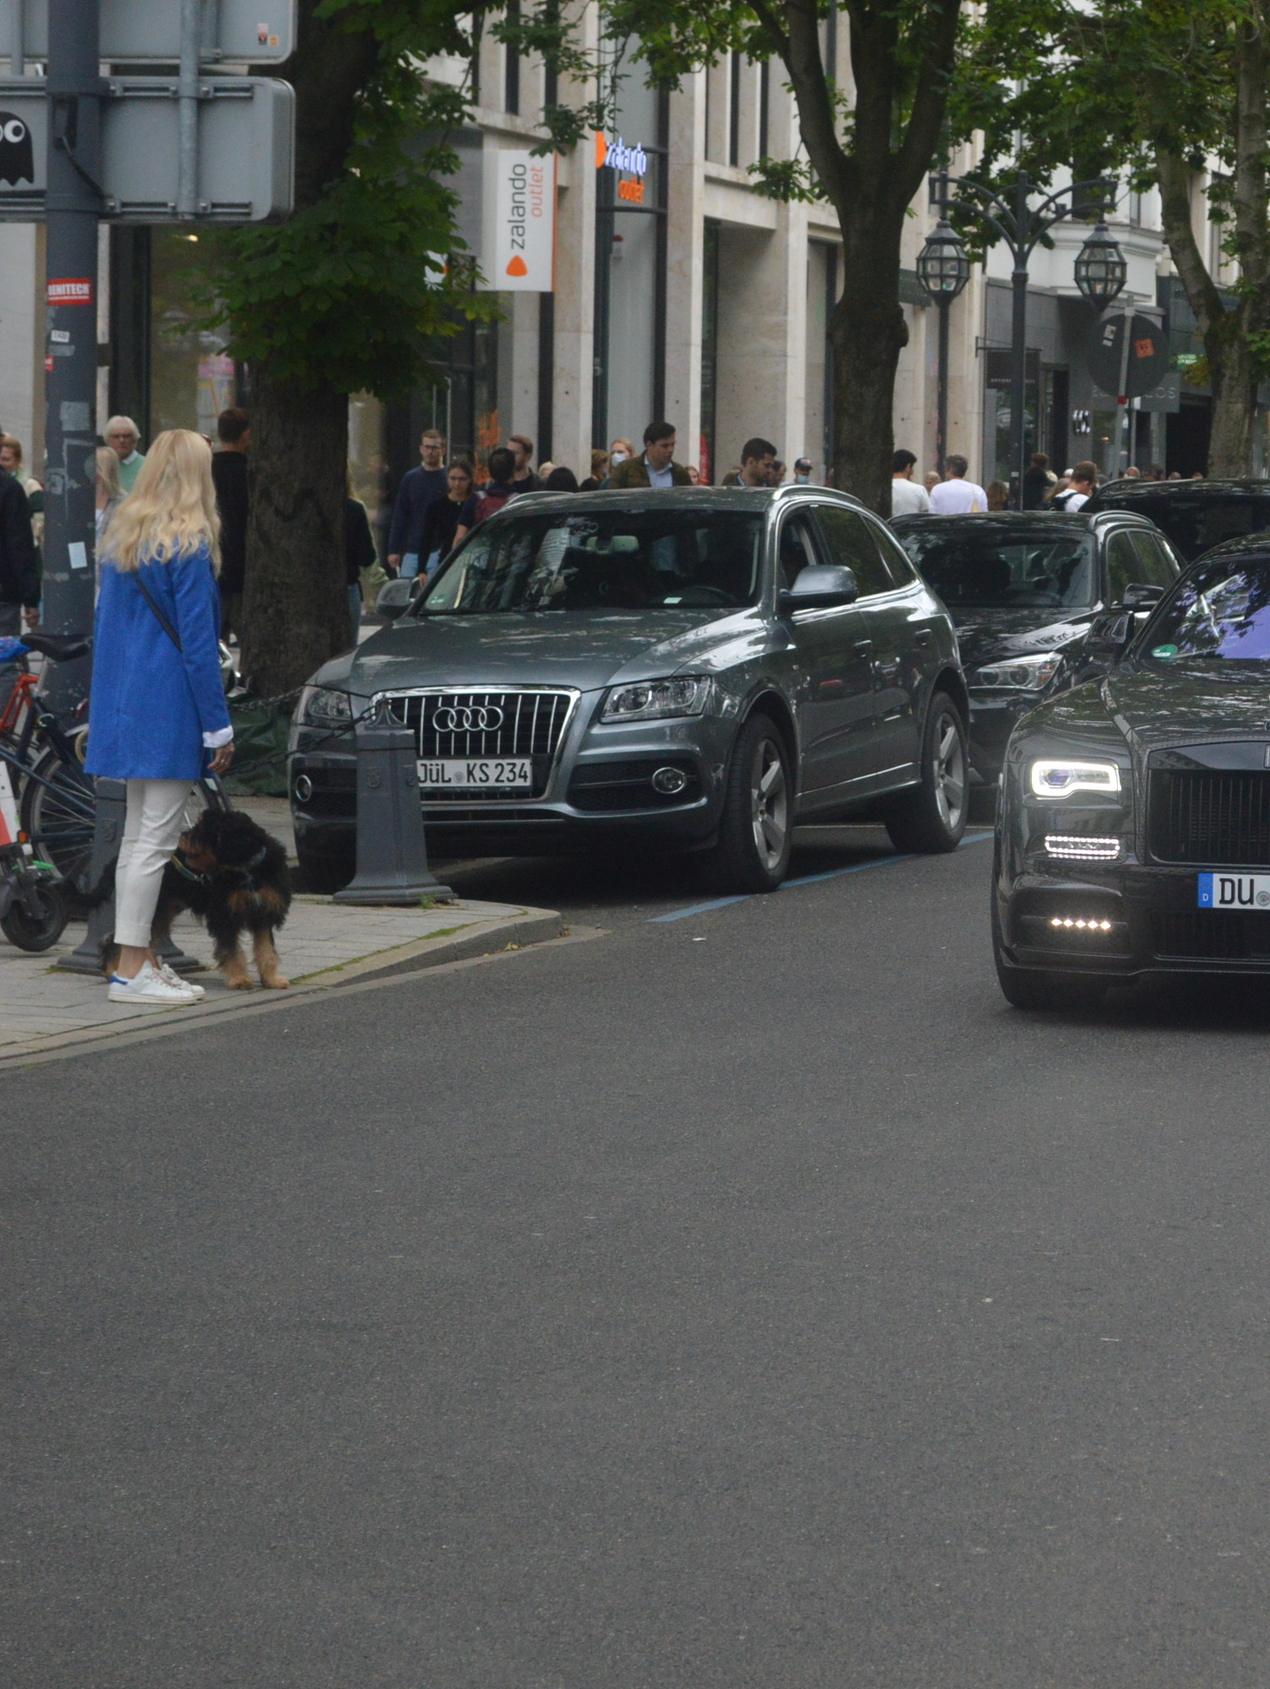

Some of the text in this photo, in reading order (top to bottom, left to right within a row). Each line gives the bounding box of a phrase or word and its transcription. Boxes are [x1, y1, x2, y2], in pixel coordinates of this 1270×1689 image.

[605, 137, 646, 176] zalando
[508, 163, 527, 250] zalando
[529, 166, 544, 218] outlet
[466, 763, 489, 783] KS
[494, 762, 528, 783] 234
[1218, 877, 1254, 906] DU
